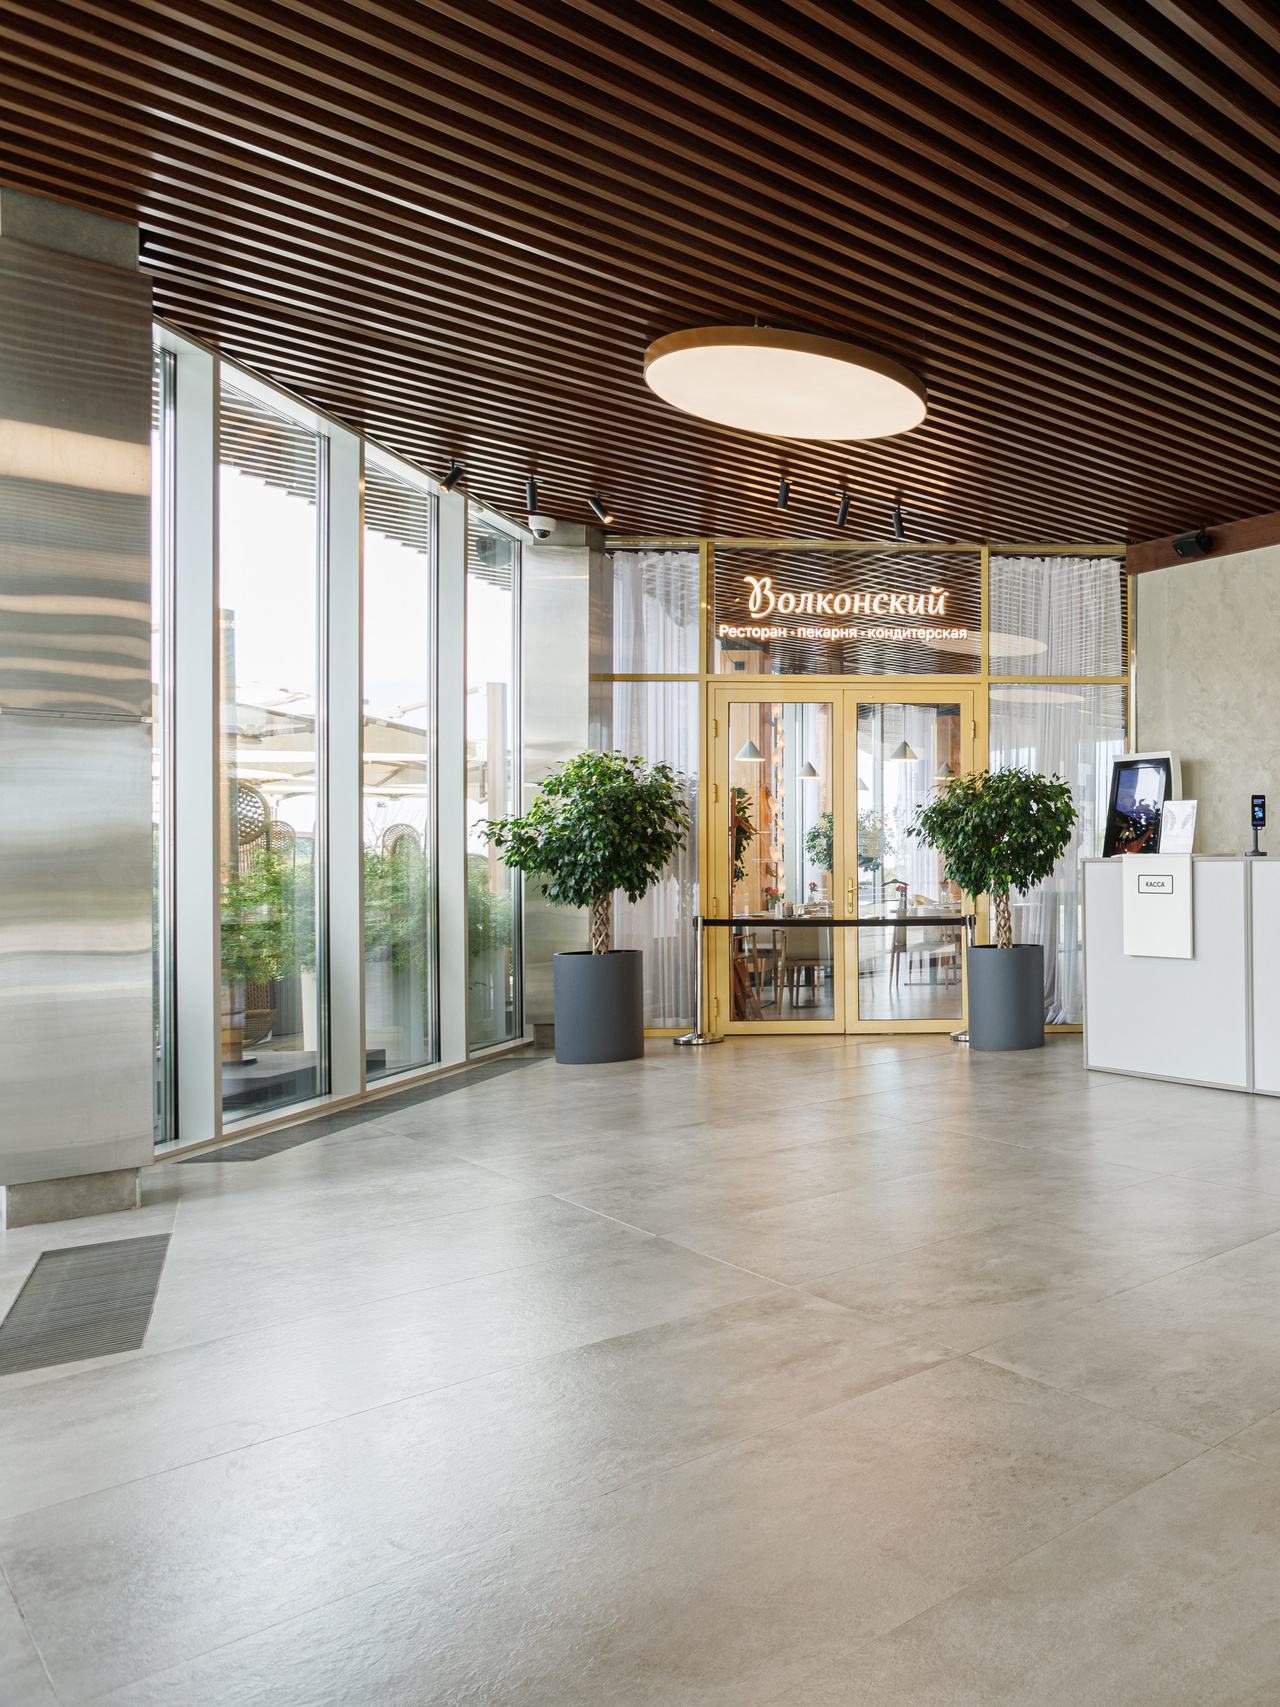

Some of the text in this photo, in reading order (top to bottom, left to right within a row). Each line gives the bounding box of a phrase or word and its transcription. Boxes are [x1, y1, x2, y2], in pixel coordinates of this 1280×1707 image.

[743, 576, 950, 618] Волконский
[719, 625, 968, 641] Ресторан пекарня кондитерская
